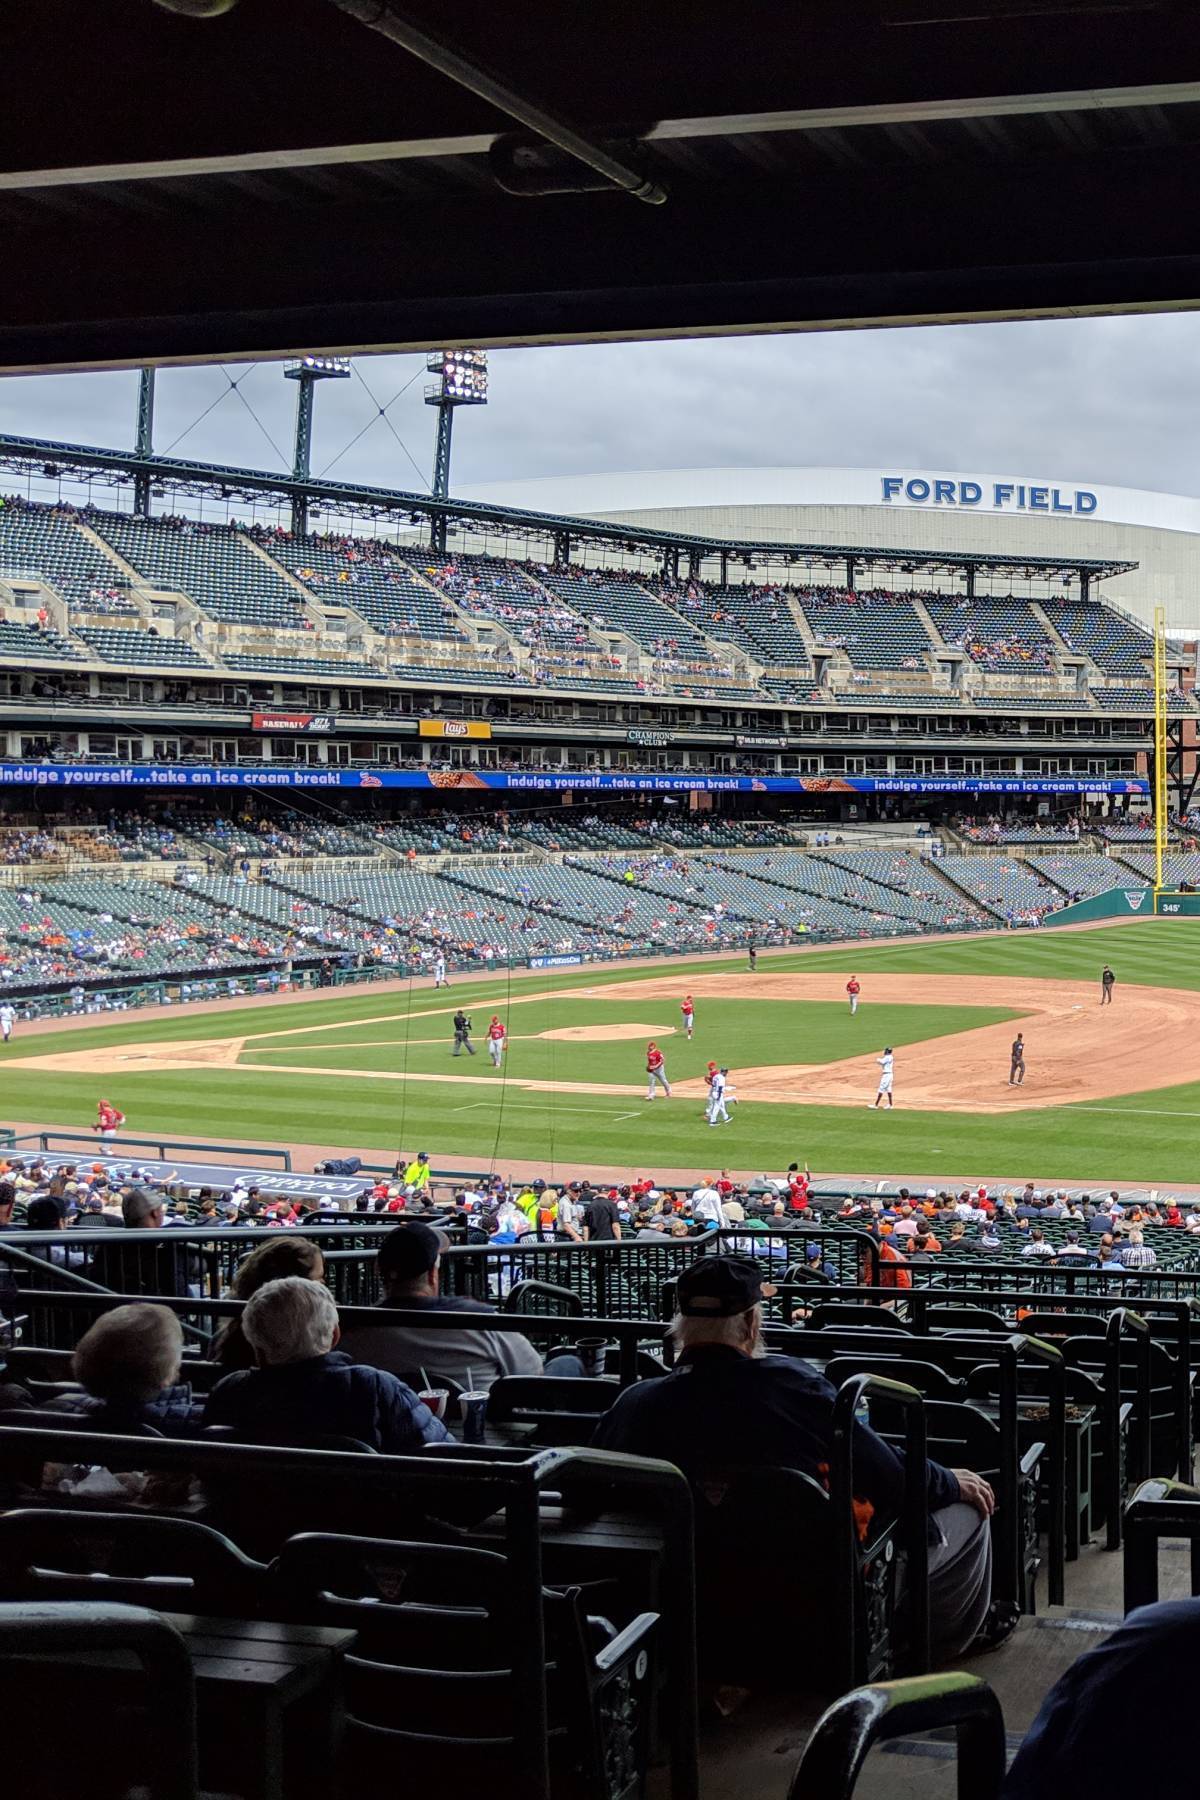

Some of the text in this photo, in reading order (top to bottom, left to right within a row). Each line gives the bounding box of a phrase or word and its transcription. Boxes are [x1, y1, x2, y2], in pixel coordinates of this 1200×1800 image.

[881, 477, 1098, 514] FORD FIELD
[263, 721, 305, 729] BASEBALL
[443, 722, 466, 734] Lay's
[628, 730, 674, 741] CHAMPIONS
[0, 767, 58, 784] indulge
[192, 773, 211, 784] an
[216, 770, 238, 784] ice
[244, 773, 289, 784] cream
[294, 771, 341, 785] break!
[508, 775, 551, 788] indulge
[639, 779, 651, 788] an
[655, 777, 670, 789] ice
[673, 779, 705, 789] cream
[707, 778, 739, 789] break!
[874, 780, 917, 791] indulge
[1006, 783, 1019, 791] an
[1023, 781, 1038, 791] ice
[1042, 783, 1074, 791] cream
[1077, 781, 1111, 791] break!
[1162, 904, 1180, 912] 345'
